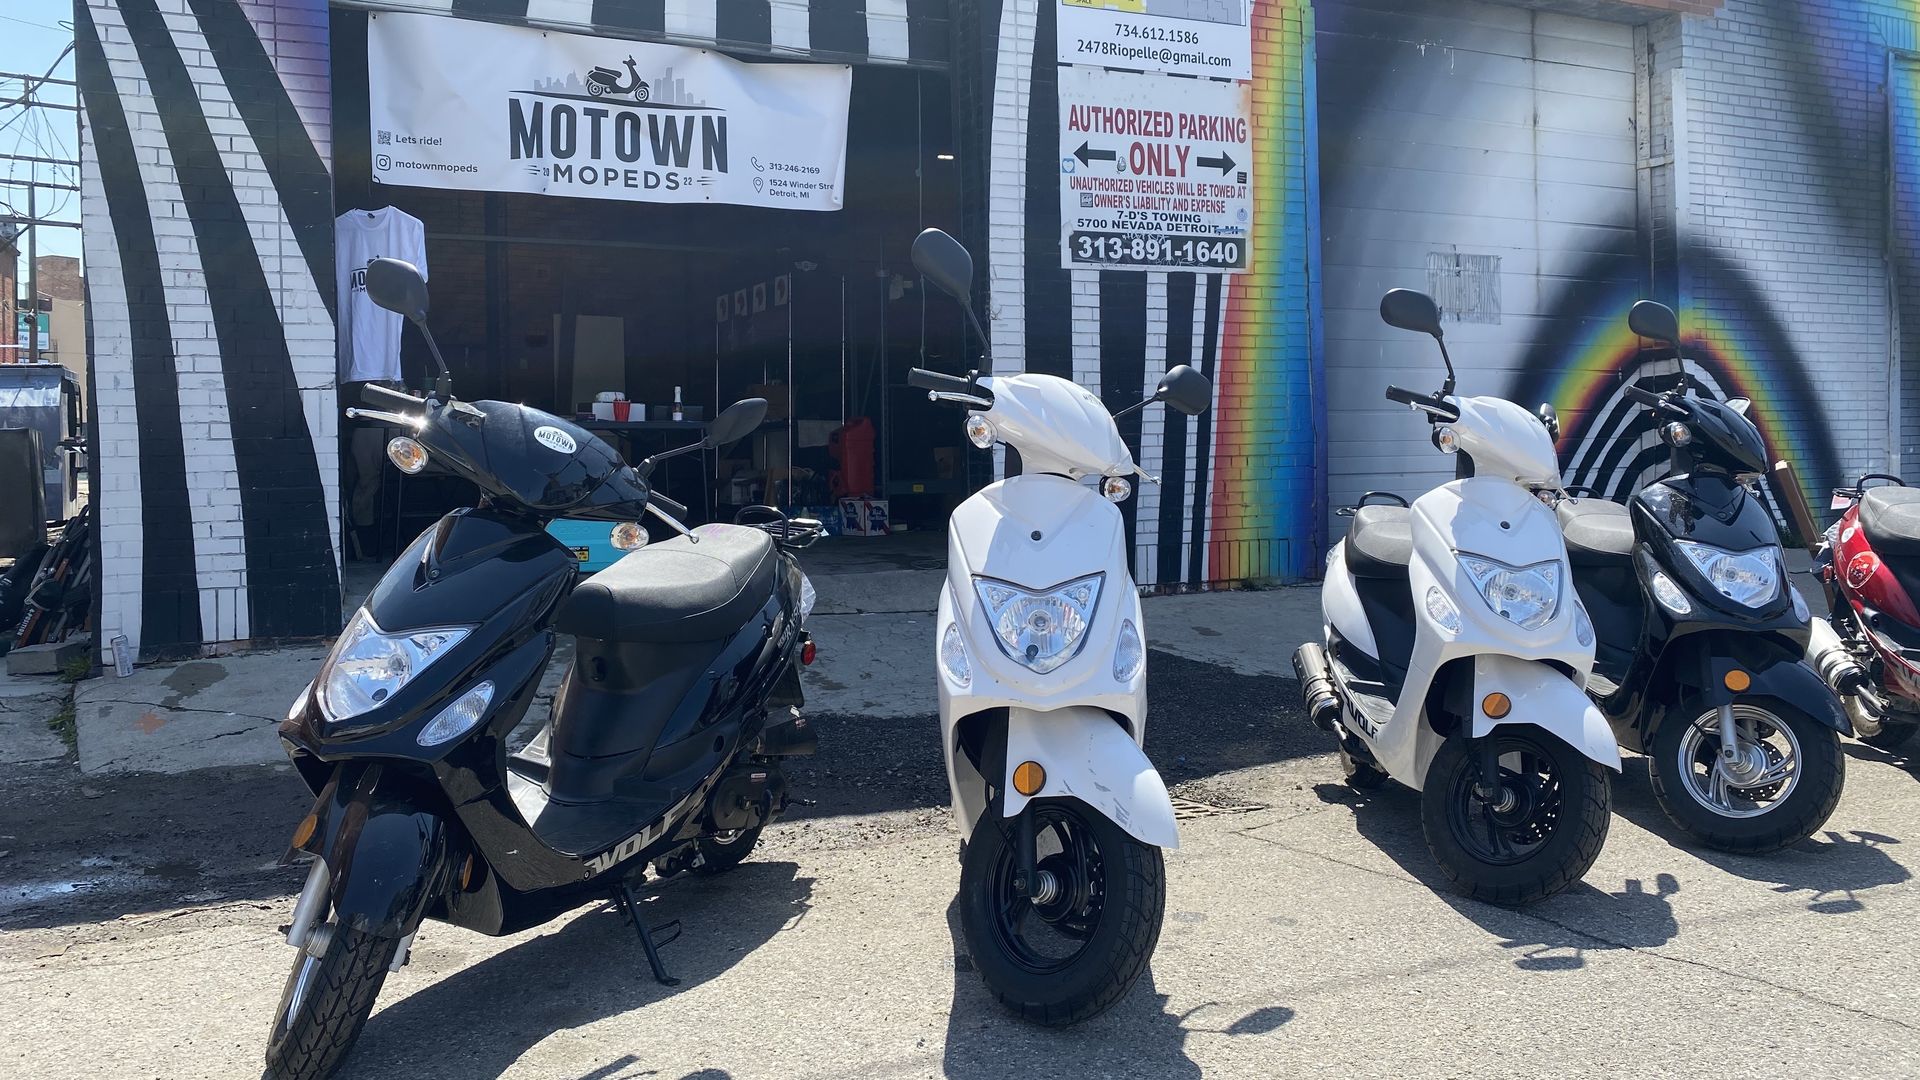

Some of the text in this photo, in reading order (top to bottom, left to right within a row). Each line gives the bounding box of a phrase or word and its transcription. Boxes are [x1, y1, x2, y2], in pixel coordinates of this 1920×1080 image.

[1115, 23, 1199, 45] 734.612.1586
[1077, 39, 1232, 67] 2478Riopelle@gmail.com
[1068, 104, 1247, 144] AUTHORIZED PARKING
[395, 134, 443, 146] Lets ride!
[508, 97, 729, 174] MOTOWN
[395, 160, 478, 173] motownmopeds
[769, 162, 820, 174] 313-246-2169
[1129, 141, 1191, 178] ONLY
[542, 163, 693, 191] 20 MOPEDS 22
[769, 178, 788, 187] 1524
[789, 180, 817, 189] Winder
[1070, 176, 1247, 199] UNAUTHORIZED VEHICLES WILL BE TOWED AT
[769, 188, 810, 199] Detroit, MI
[1094, 193, 1226, 214] OWNER'S LIABILITY AND EXPENSE
[1077, 218, 1108, 228] 5700
[1112, 220, 1162, 231] NEVADA
[1117, 210, 1202, 223] 7-D'S TOWING
[1078, 235, 1238, 263] 313-891-1640
[538, 430, 574, 451] MOTOWN
